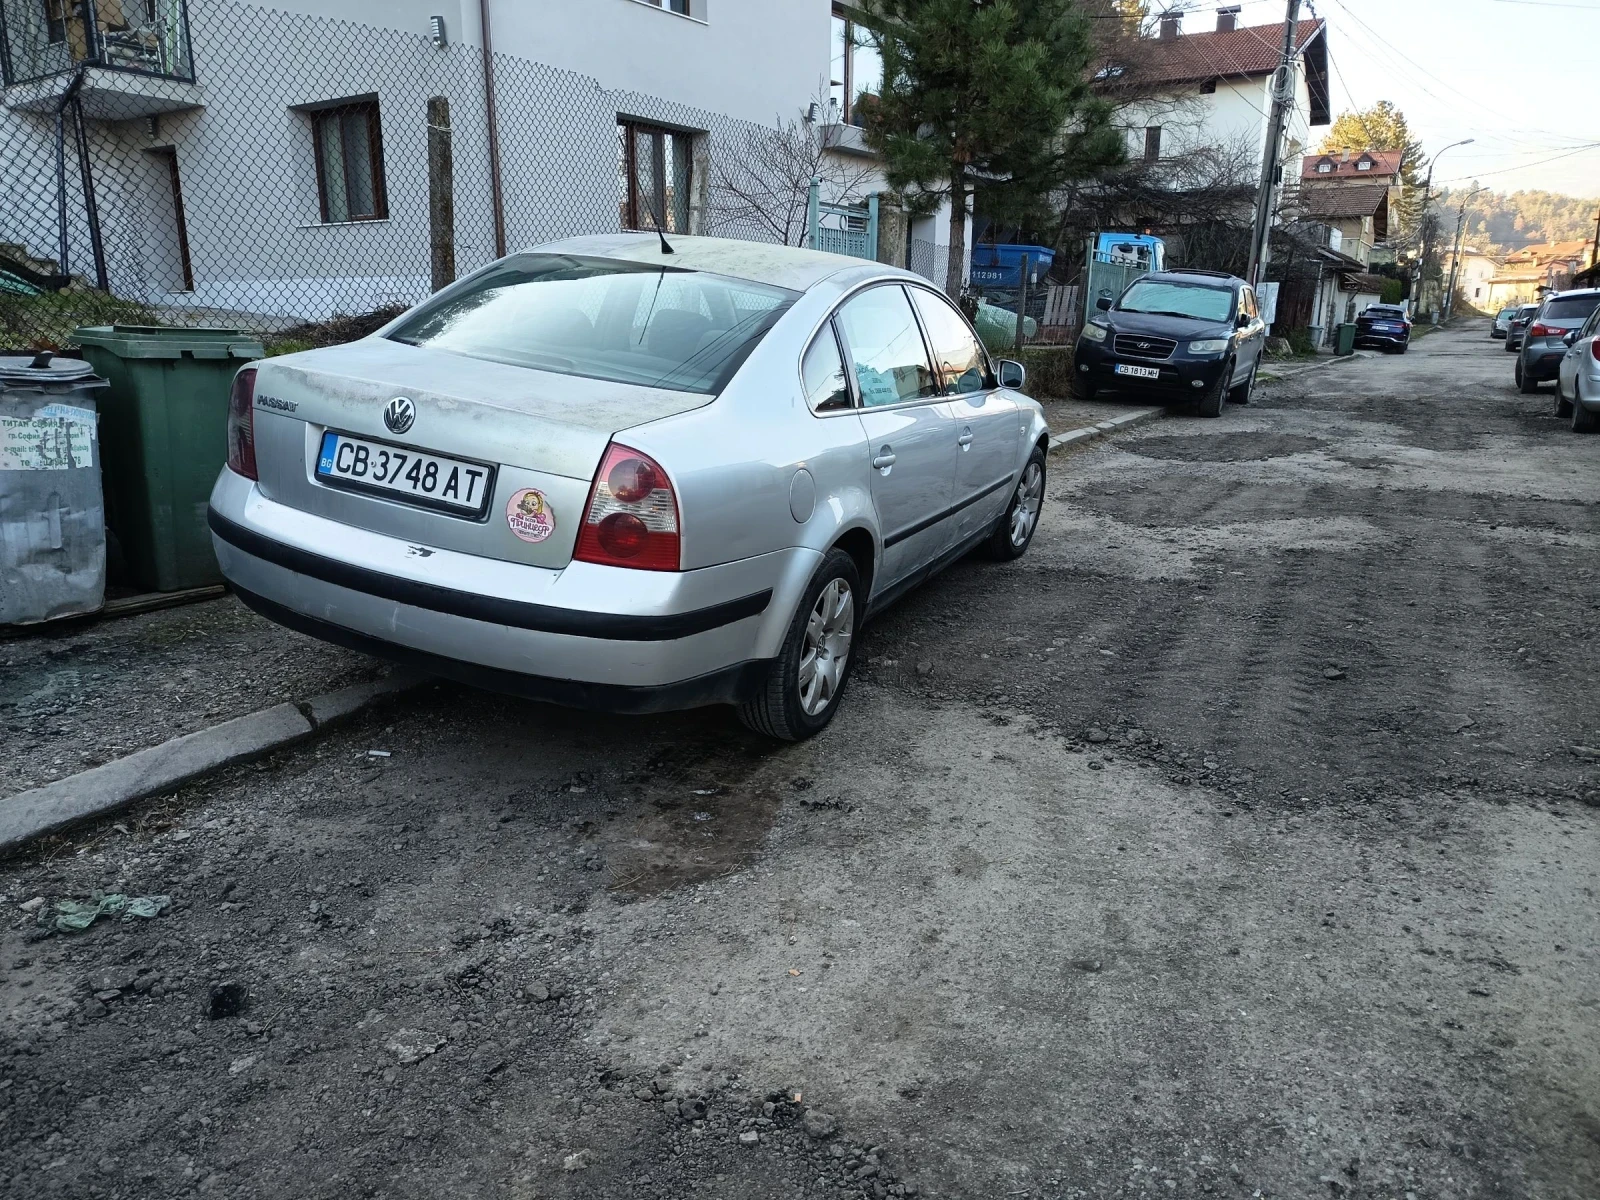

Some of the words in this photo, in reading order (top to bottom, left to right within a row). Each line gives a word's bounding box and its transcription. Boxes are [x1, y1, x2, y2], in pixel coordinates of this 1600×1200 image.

[256, 394, 300, 413] PASSAT
[1, 419, 29, 428] ТИТАН
[320, 457, 334, 469] BG
[336, 442, 370, 477] CB
[372, 450, 439, 493] 3748
[442, 466, 483, 502] AT
